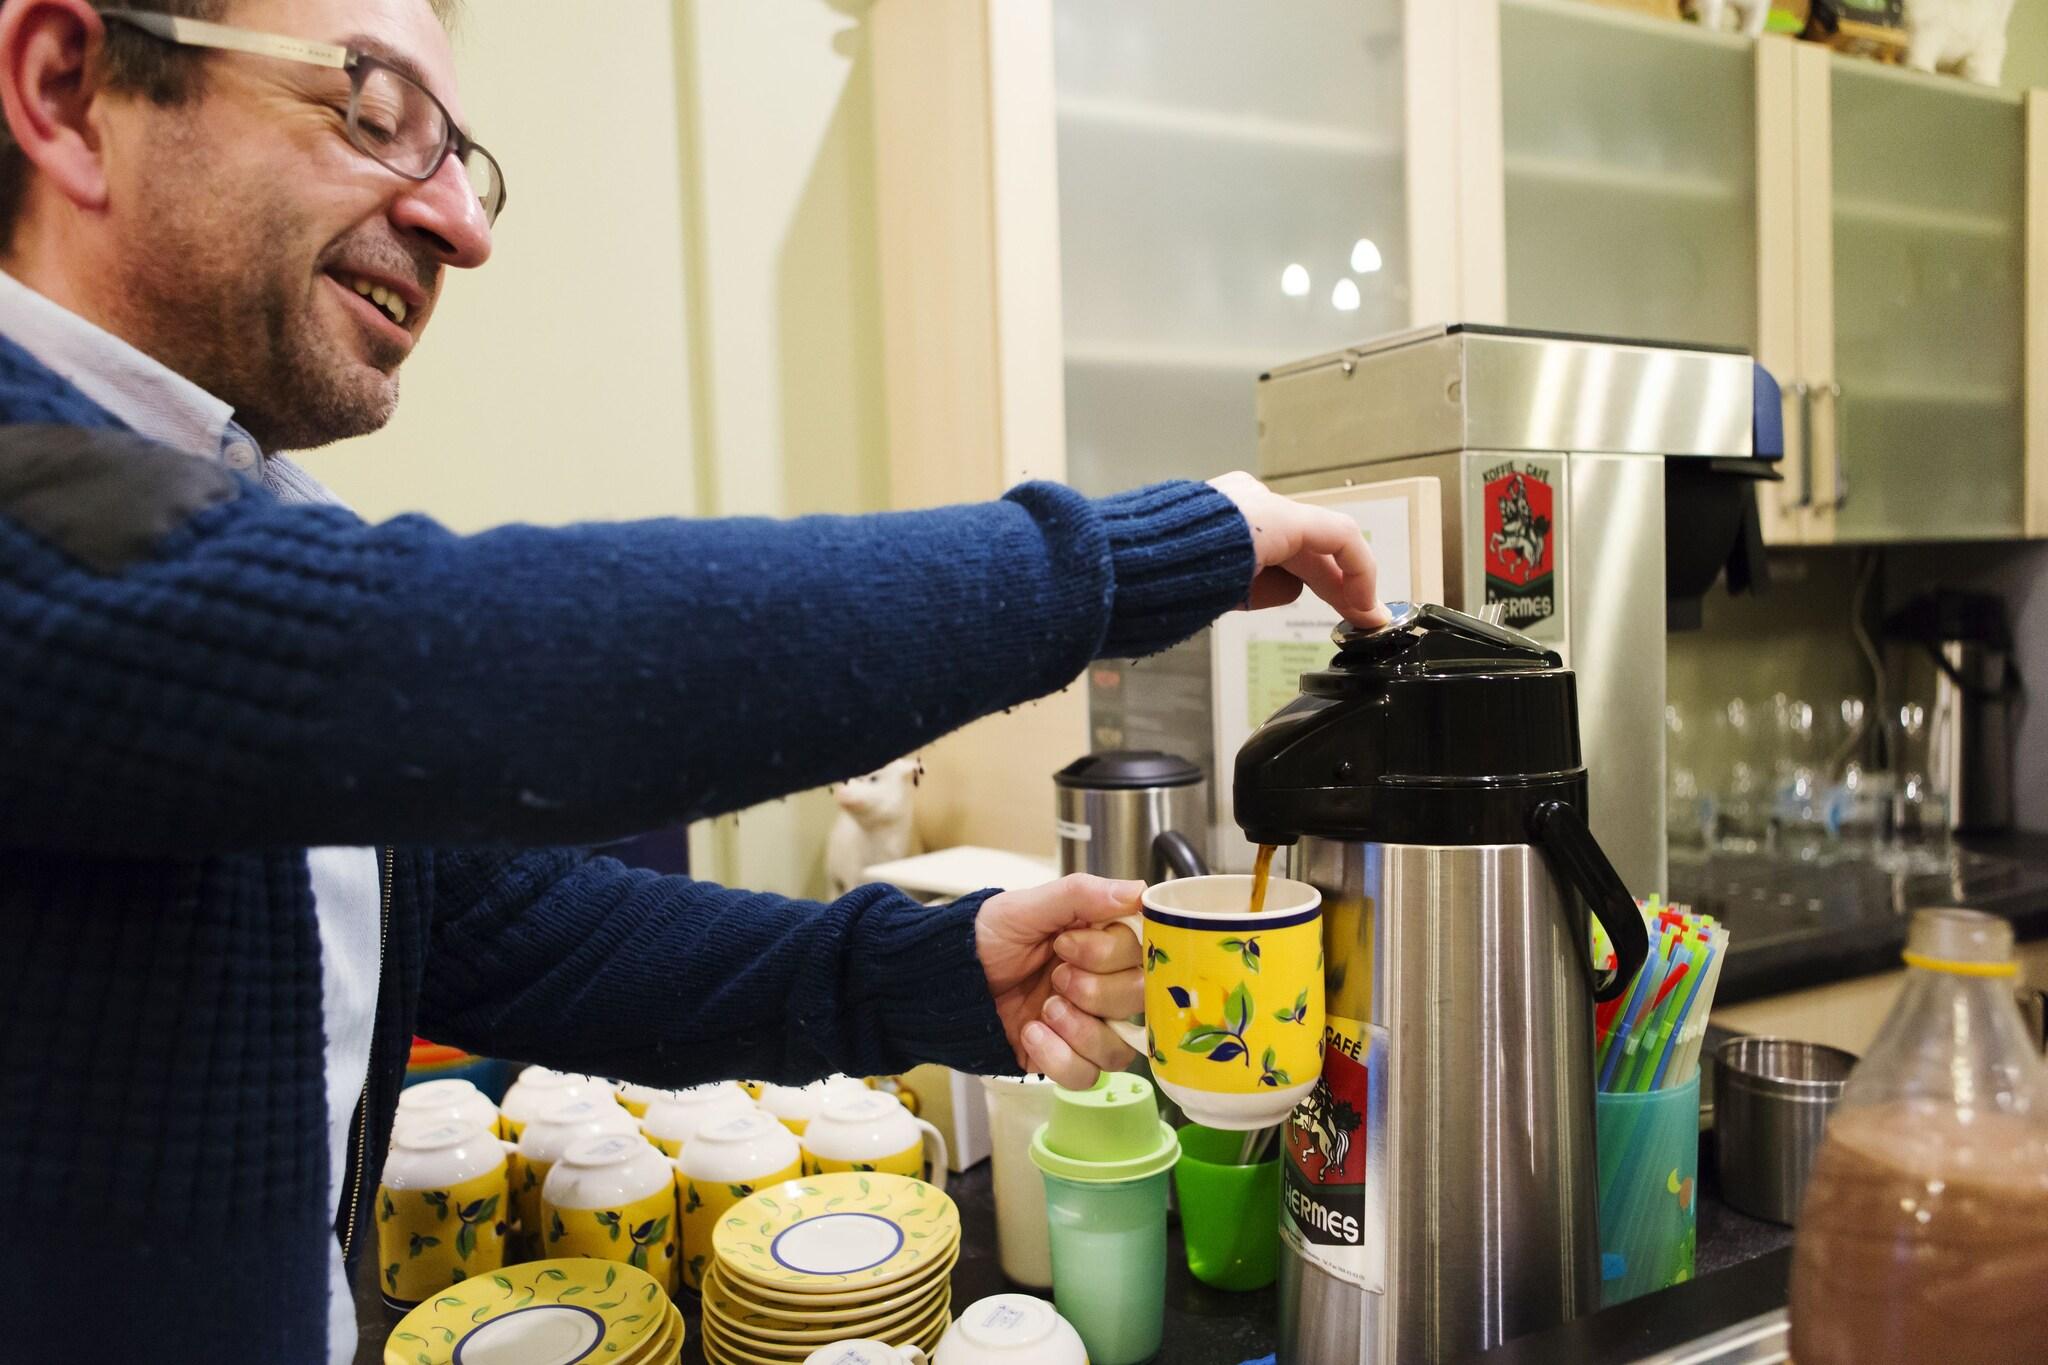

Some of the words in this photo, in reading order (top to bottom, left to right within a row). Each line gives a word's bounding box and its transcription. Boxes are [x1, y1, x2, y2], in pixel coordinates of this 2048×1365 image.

[1482, 460, 1514, 483] KOFFIE
[1325, 1025, 1362, 1060] CAFÉ
[1285, 1181, 1359, 1243] HERMES
